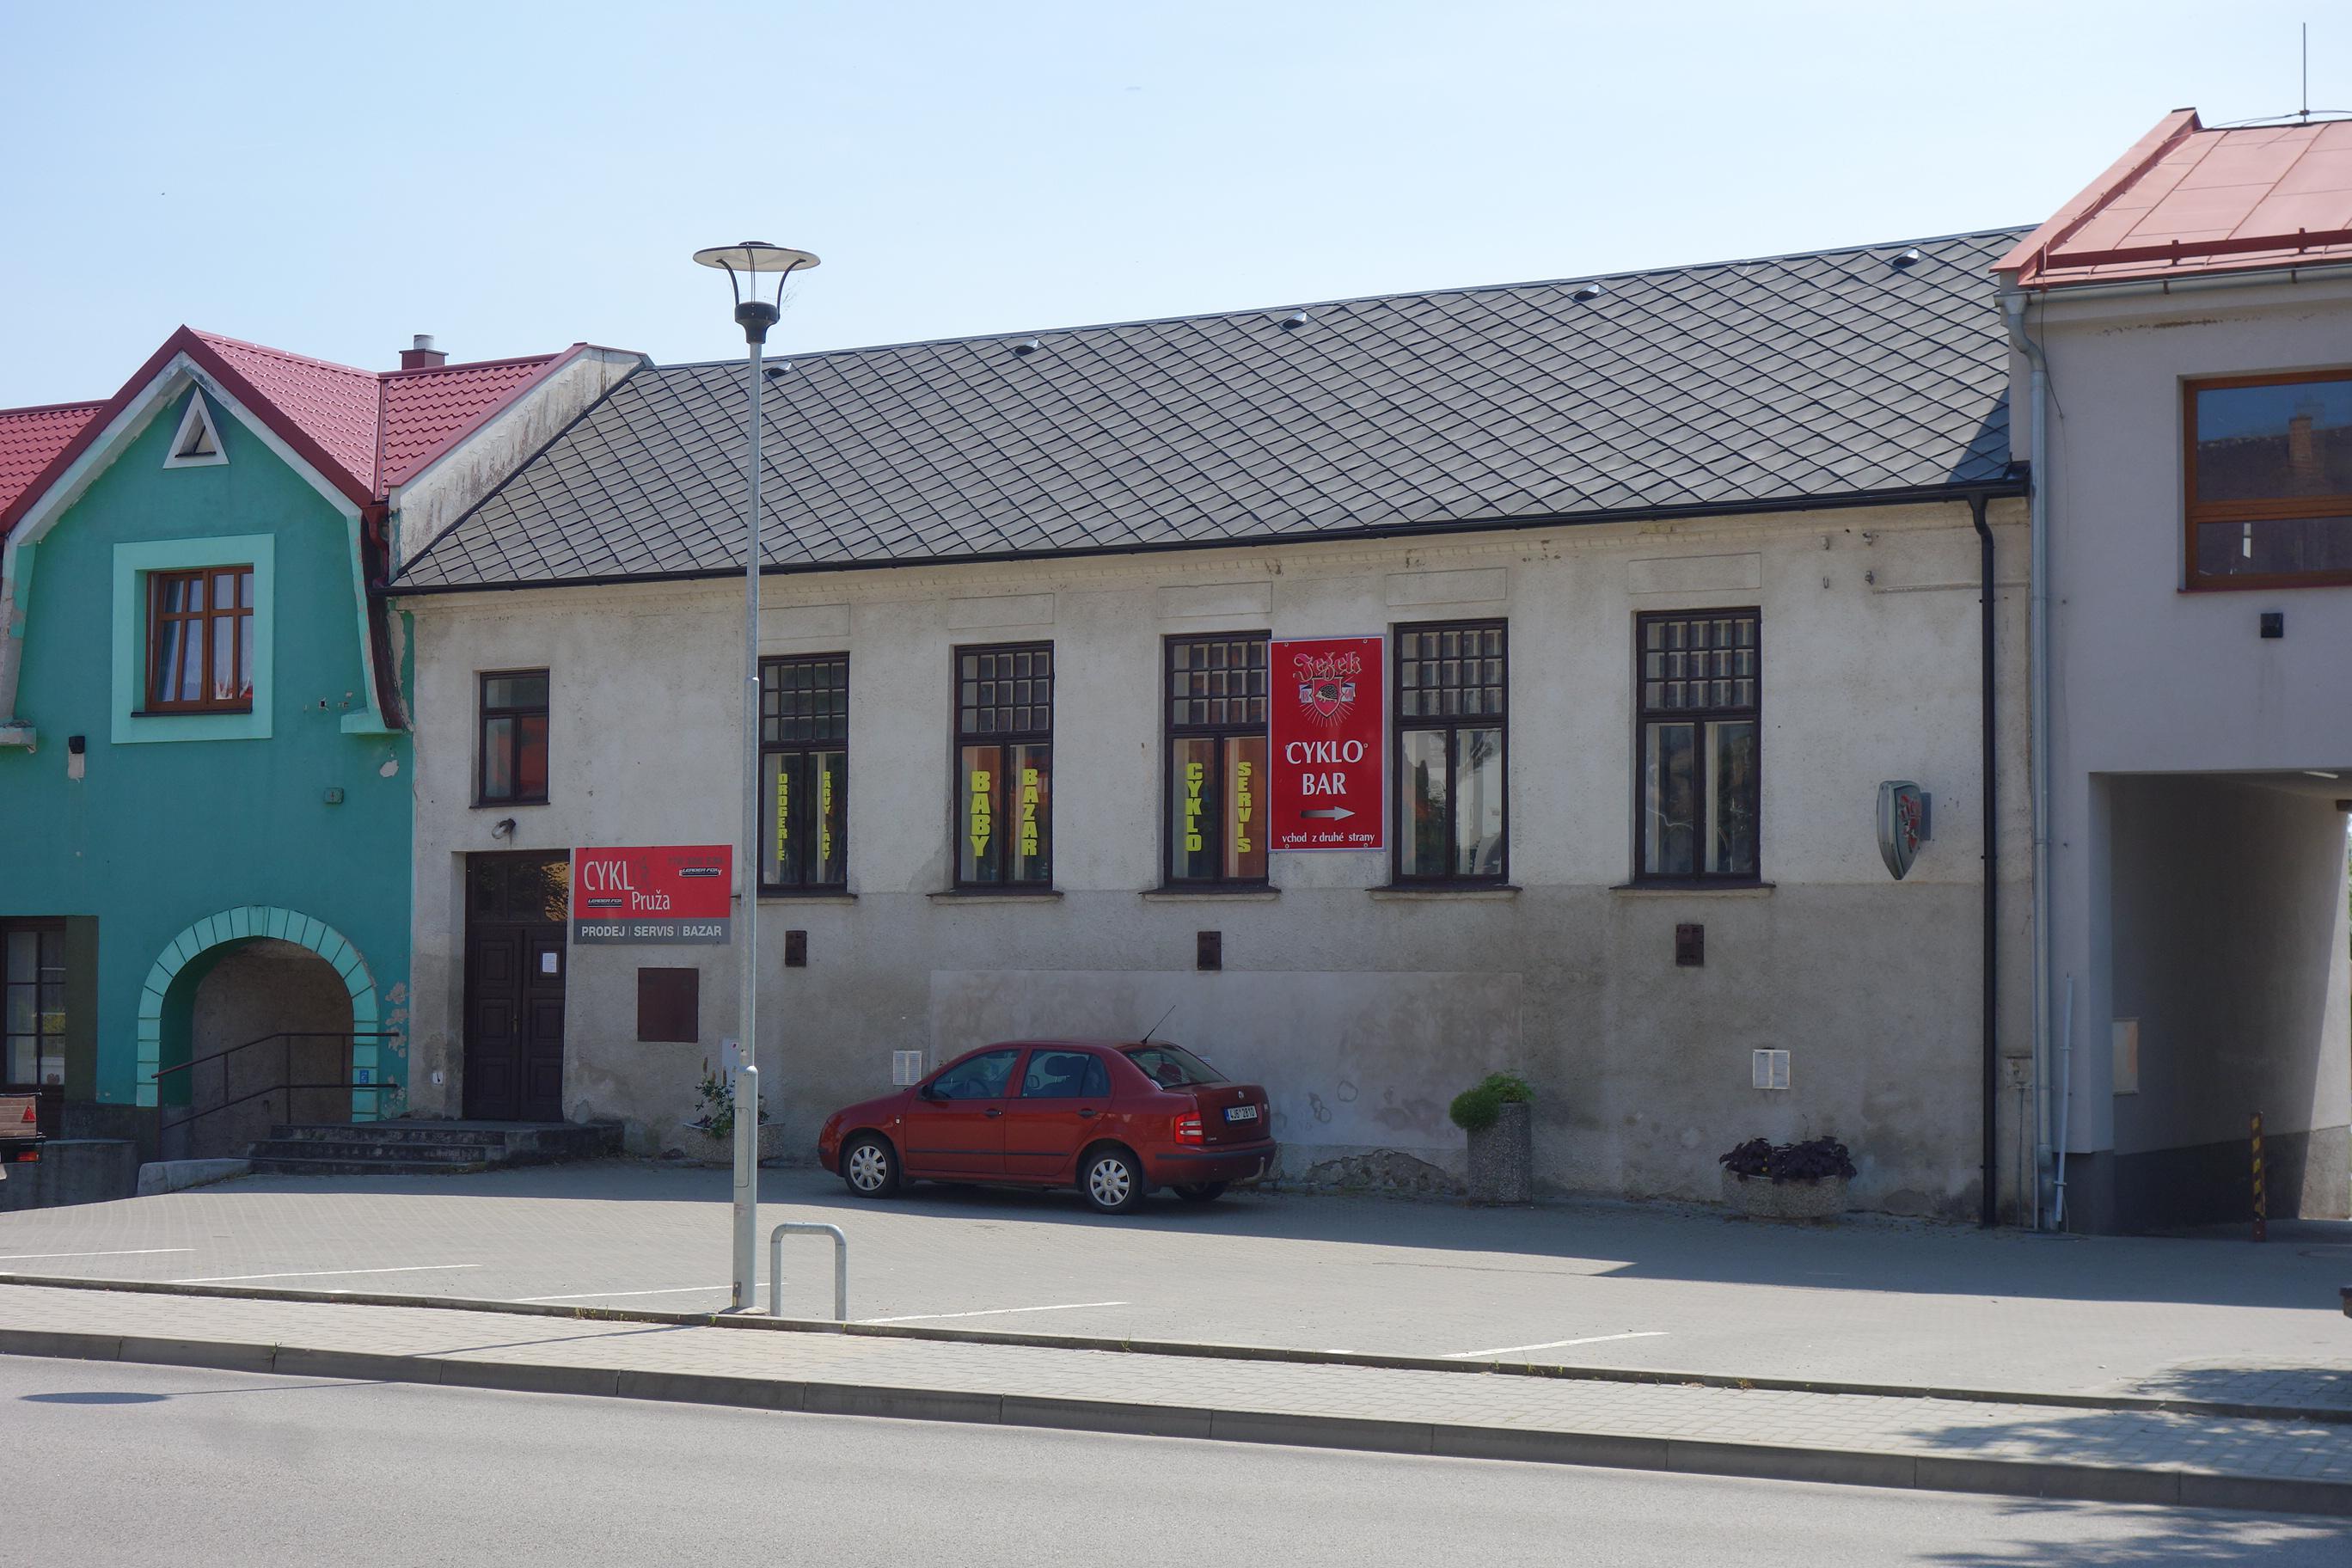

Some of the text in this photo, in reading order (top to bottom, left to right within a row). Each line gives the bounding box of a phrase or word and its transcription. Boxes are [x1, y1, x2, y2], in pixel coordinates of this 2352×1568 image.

[1292, 651, 1363, 682] Ježek
[1285, 739, 1364, 765] CYKLO
[1302, 772, 1347, 796] BAR
[777, 773, 788, 861] DROGERIE
[970, 770, 991, 856] BABY
[1021, 769, 1038, 855] BAZAR
[1185, 763, 1204, 852] CYKLO
[1237, 762, 1253, 853] SERVIS
[1282, 831, 1308, 843] vchod
[1319, 831, 1344, 842] druhé
[1348, 832, 1375, 844] strany
[631, 889, 671, 911] Pruža
[581, 925, 722, 937] PRODEJ SERVIS BAZAR
